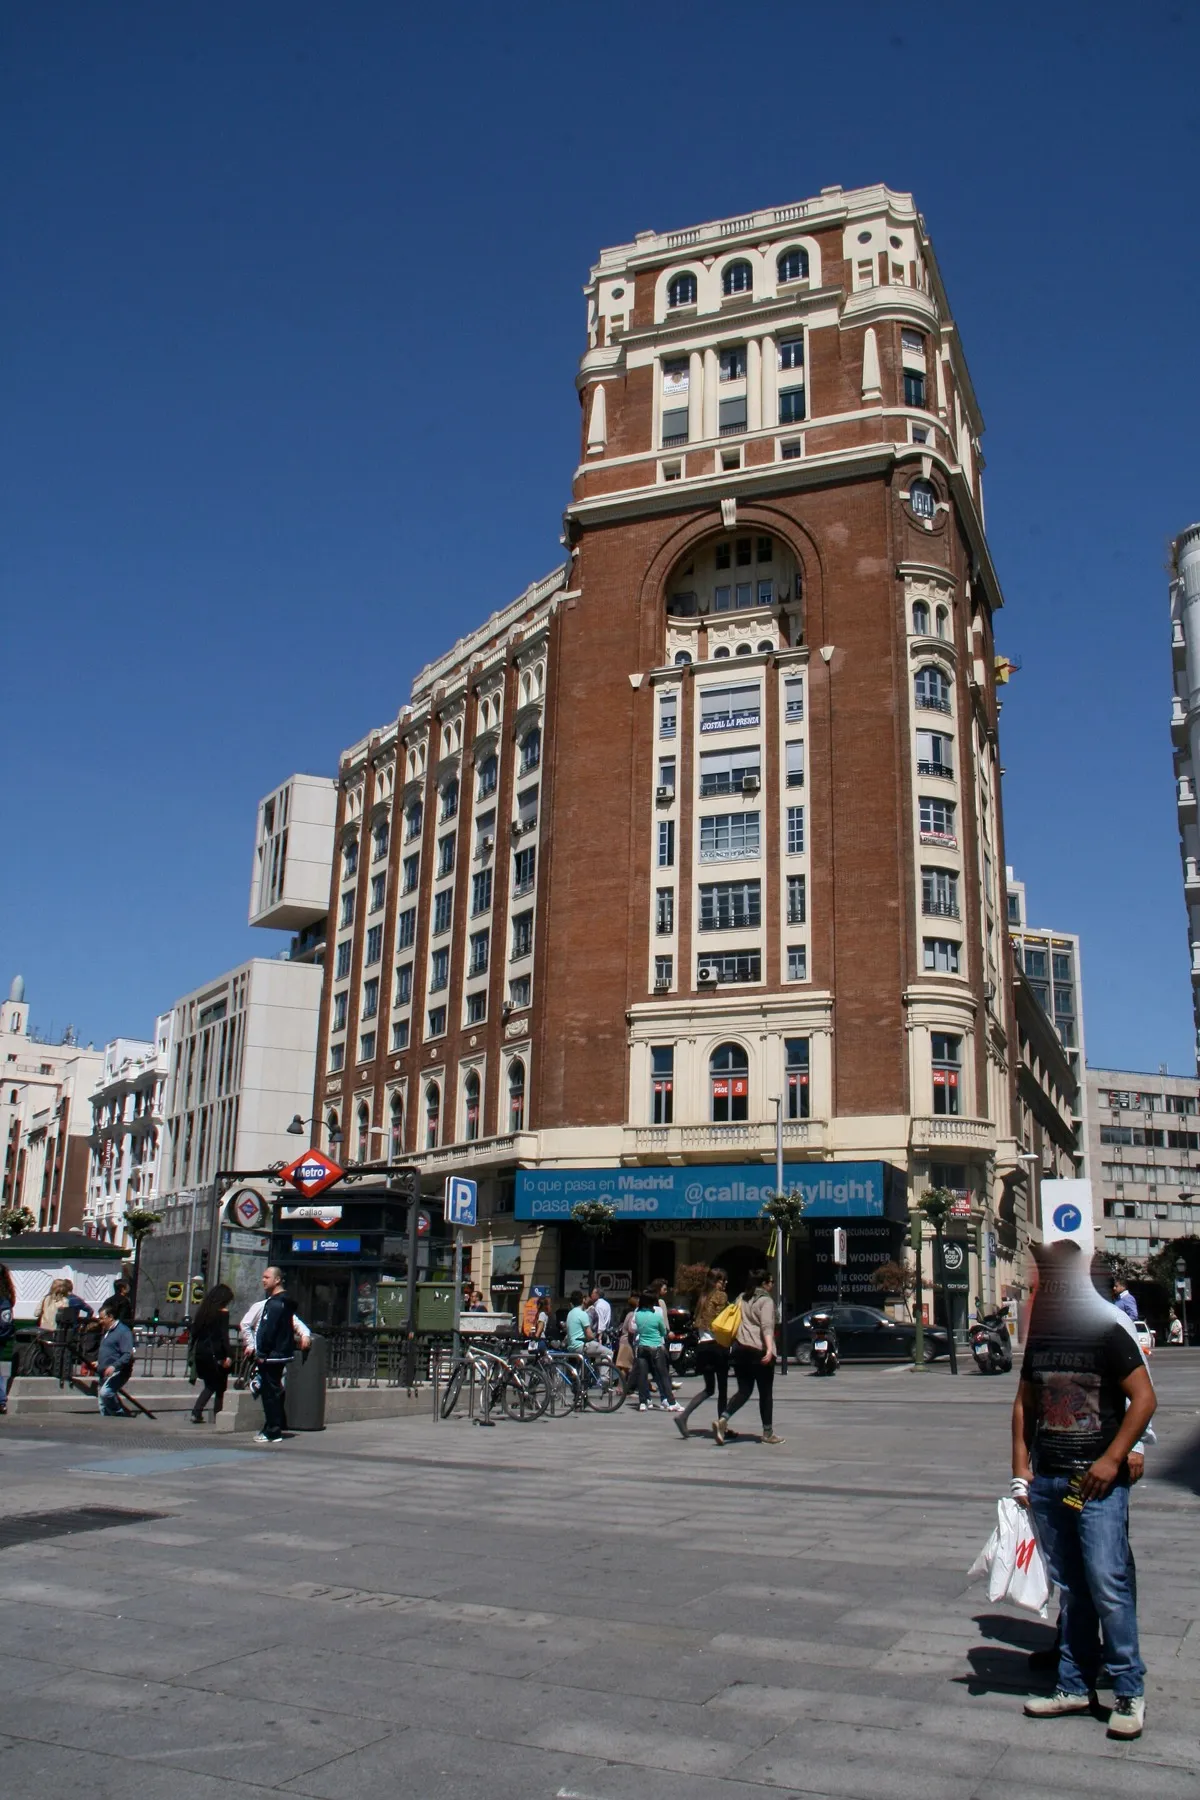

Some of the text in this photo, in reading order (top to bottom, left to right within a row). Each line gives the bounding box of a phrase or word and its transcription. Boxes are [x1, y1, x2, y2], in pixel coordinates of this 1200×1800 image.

[726, 719, 735, 727] LA
[297, 1168, 324, 1177] Metro
[523, 1175, 674, 1195] lo que pasa en Madrid
[455, 1183, 472, 1220] P
[532, 1193, 659, 1216] pasa Callao
[299, 1208, 323, 1216] Callao
[846, 1228, 891, 1237] ECUNDARIOS
[815, 1253, 828, 1263] TO
[849, 1253, 892, 1263] WONDER
[597, 1272, 632, 1291] Ohm
[817, 1284, 851, 1293] GRANES
